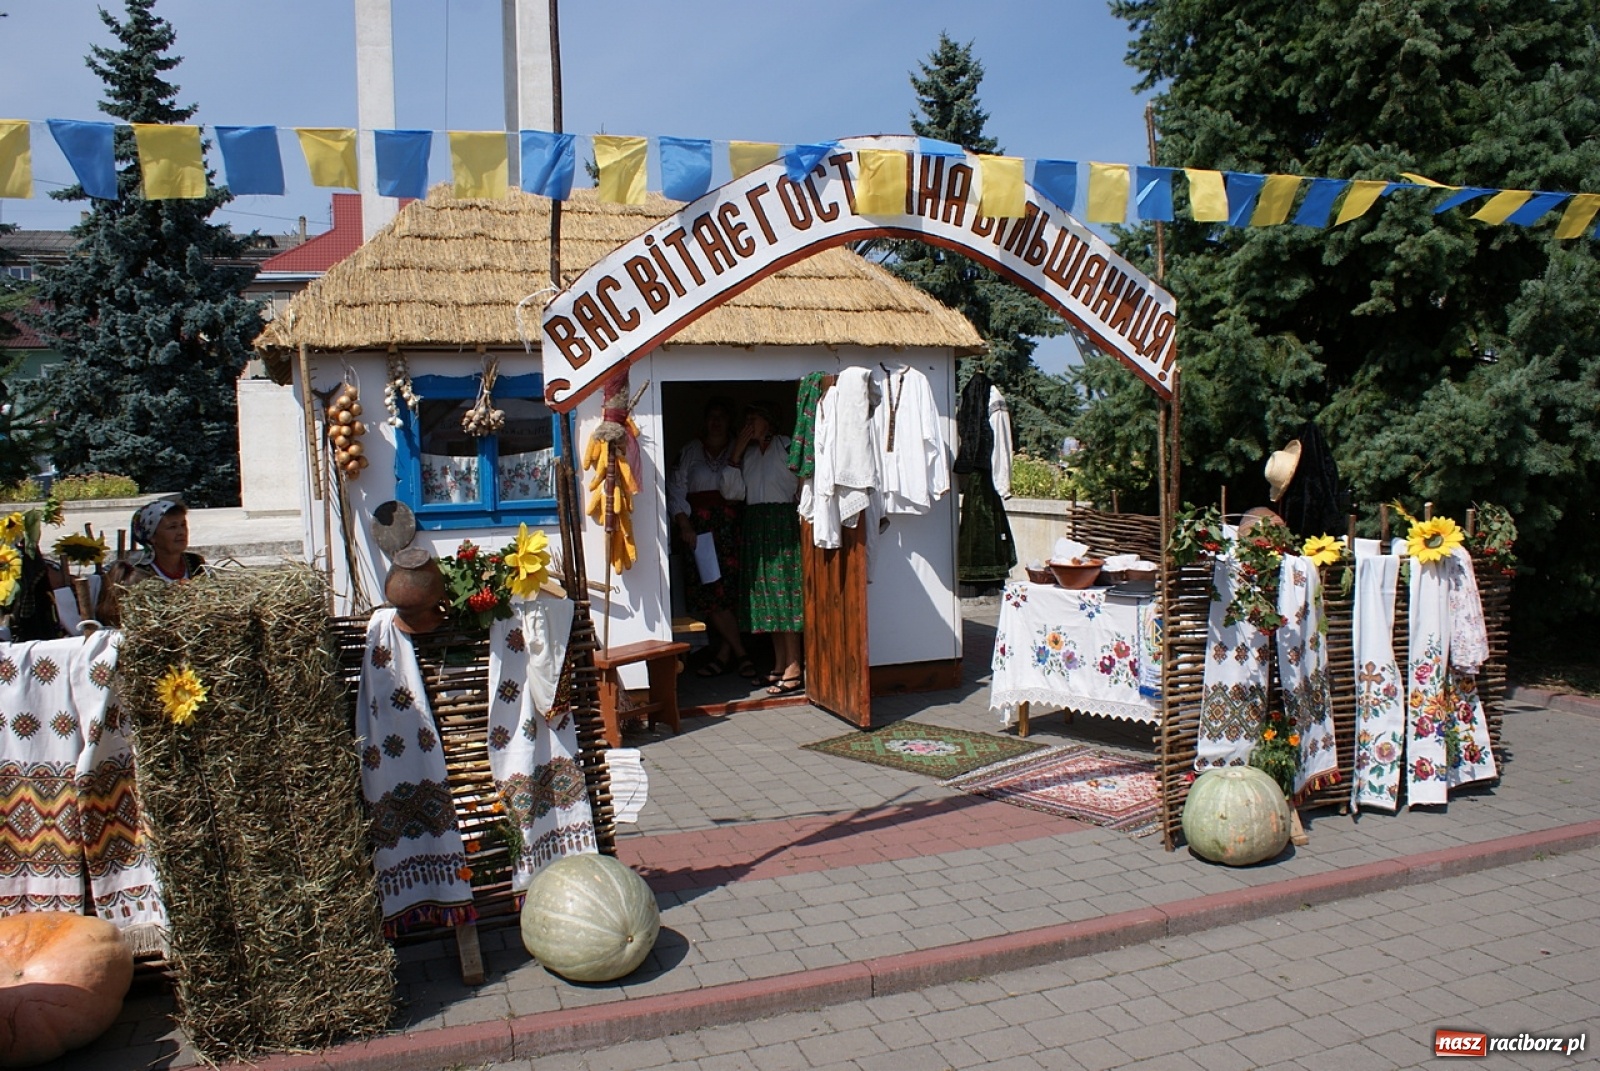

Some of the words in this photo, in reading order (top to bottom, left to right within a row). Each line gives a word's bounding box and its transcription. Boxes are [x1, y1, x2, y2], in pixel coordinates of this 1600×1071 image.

[543, 275, 641, 370] ВАС
[624, 201, 756, 315] ВІТАЄ
[746, 150, 973, 246] ГОСТНА
